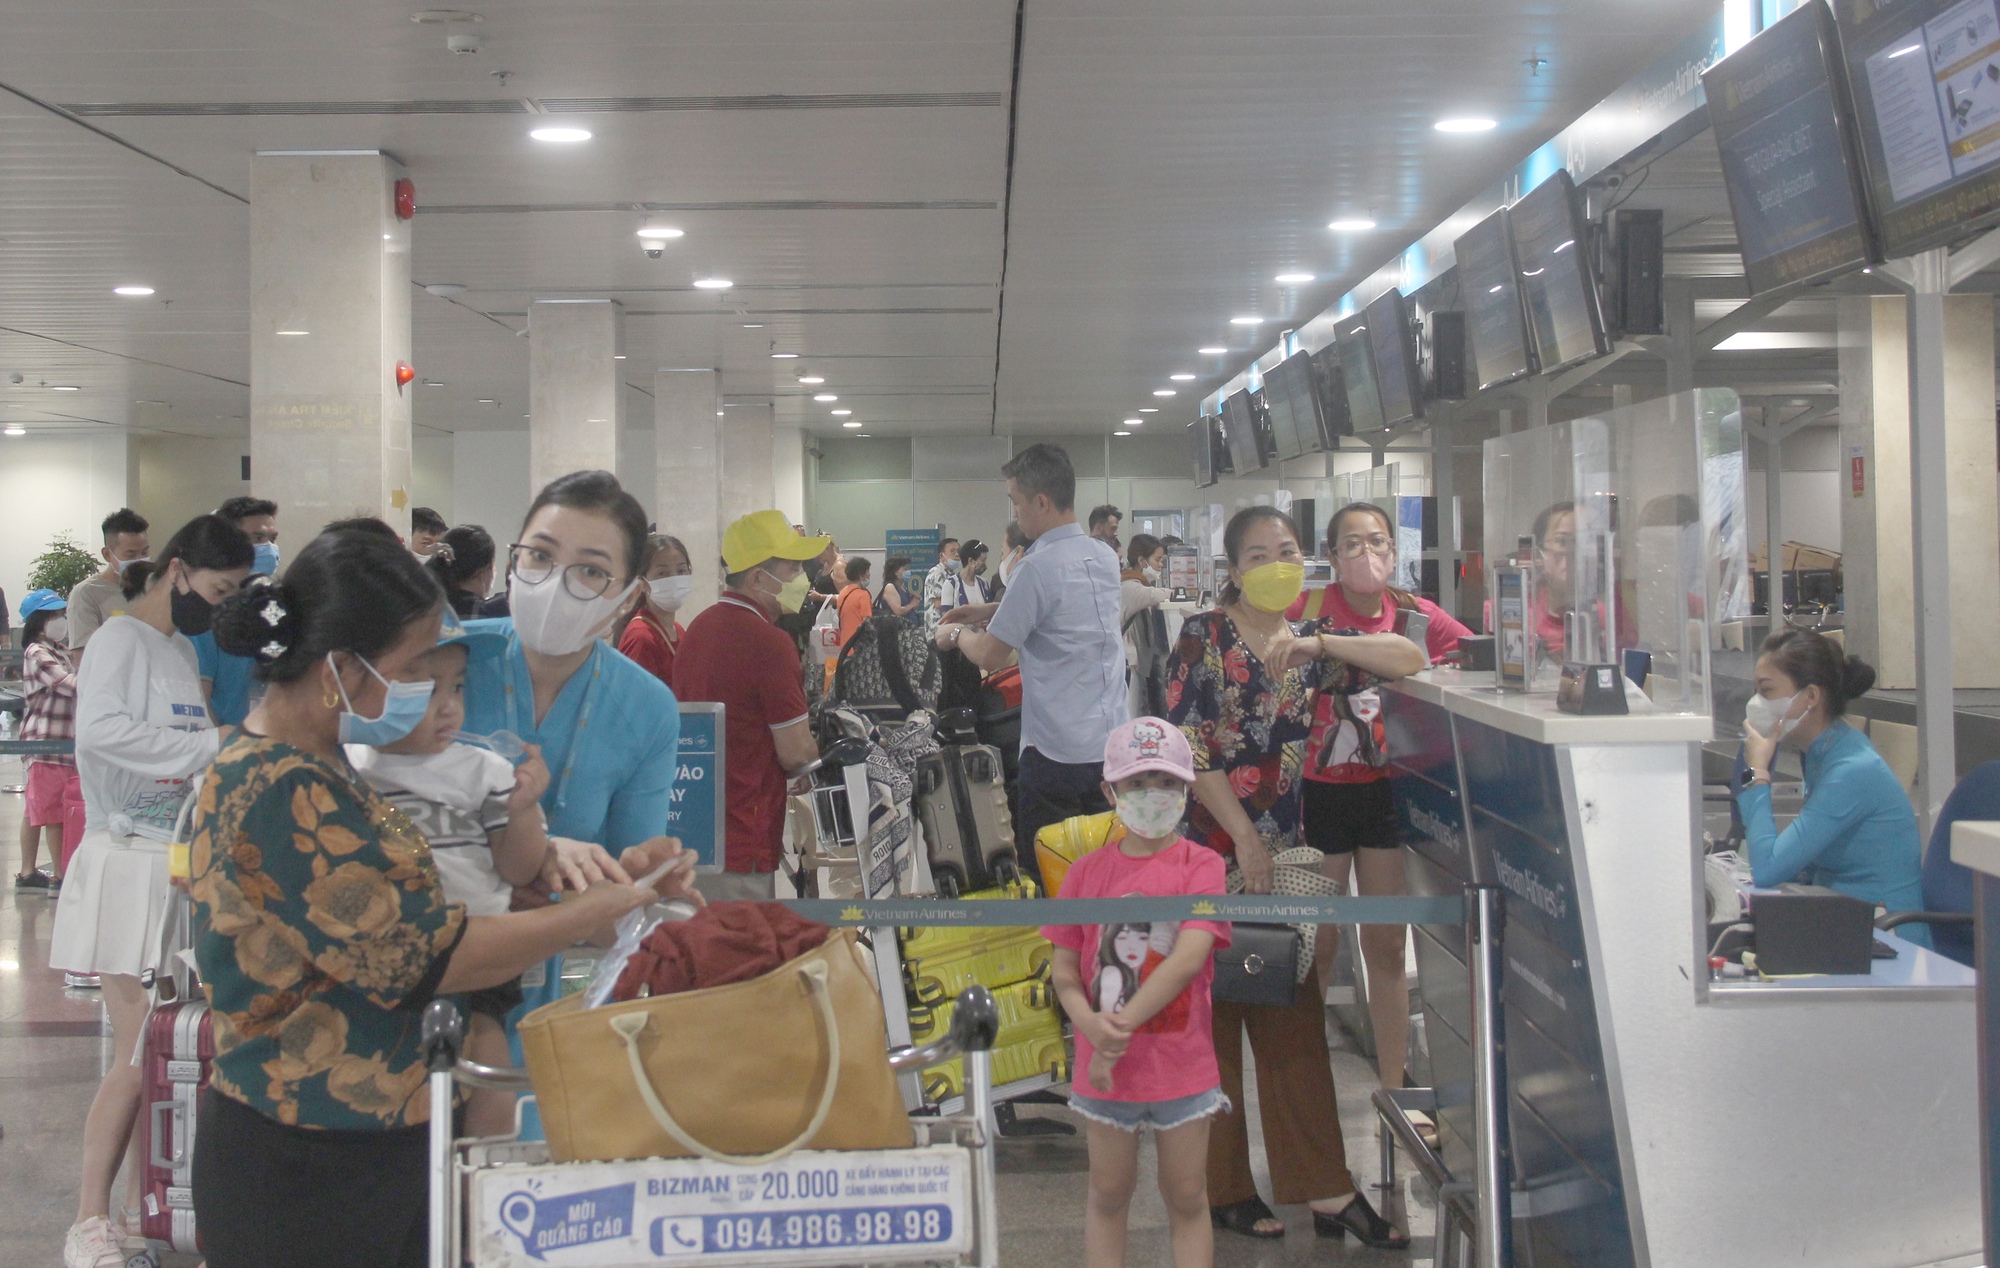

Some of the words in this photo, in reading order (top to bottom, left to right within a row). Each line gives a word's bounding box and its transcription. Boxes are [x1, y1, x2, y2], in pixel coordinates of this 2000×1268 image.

[1566, 131, 1586, 177] A-3
[1524, 868, 1558, 919] Airlines
[865, 908, 918, 920] Vietnam
[919, 907, 967, 919] Airlines
[1217, 904, 1271, 916] Vietnam
[1271, 904, 1319, 916] Airlines
[647, 1175, 731, 1196] BIZMAN
[762, 1169, 839, 1200] 20.000
[568, 1199, 596, 1222] MỜI
[592, 1215, 622, 1239] CÁO
[717, 1208, 941, 1248] 094.986.98.98
